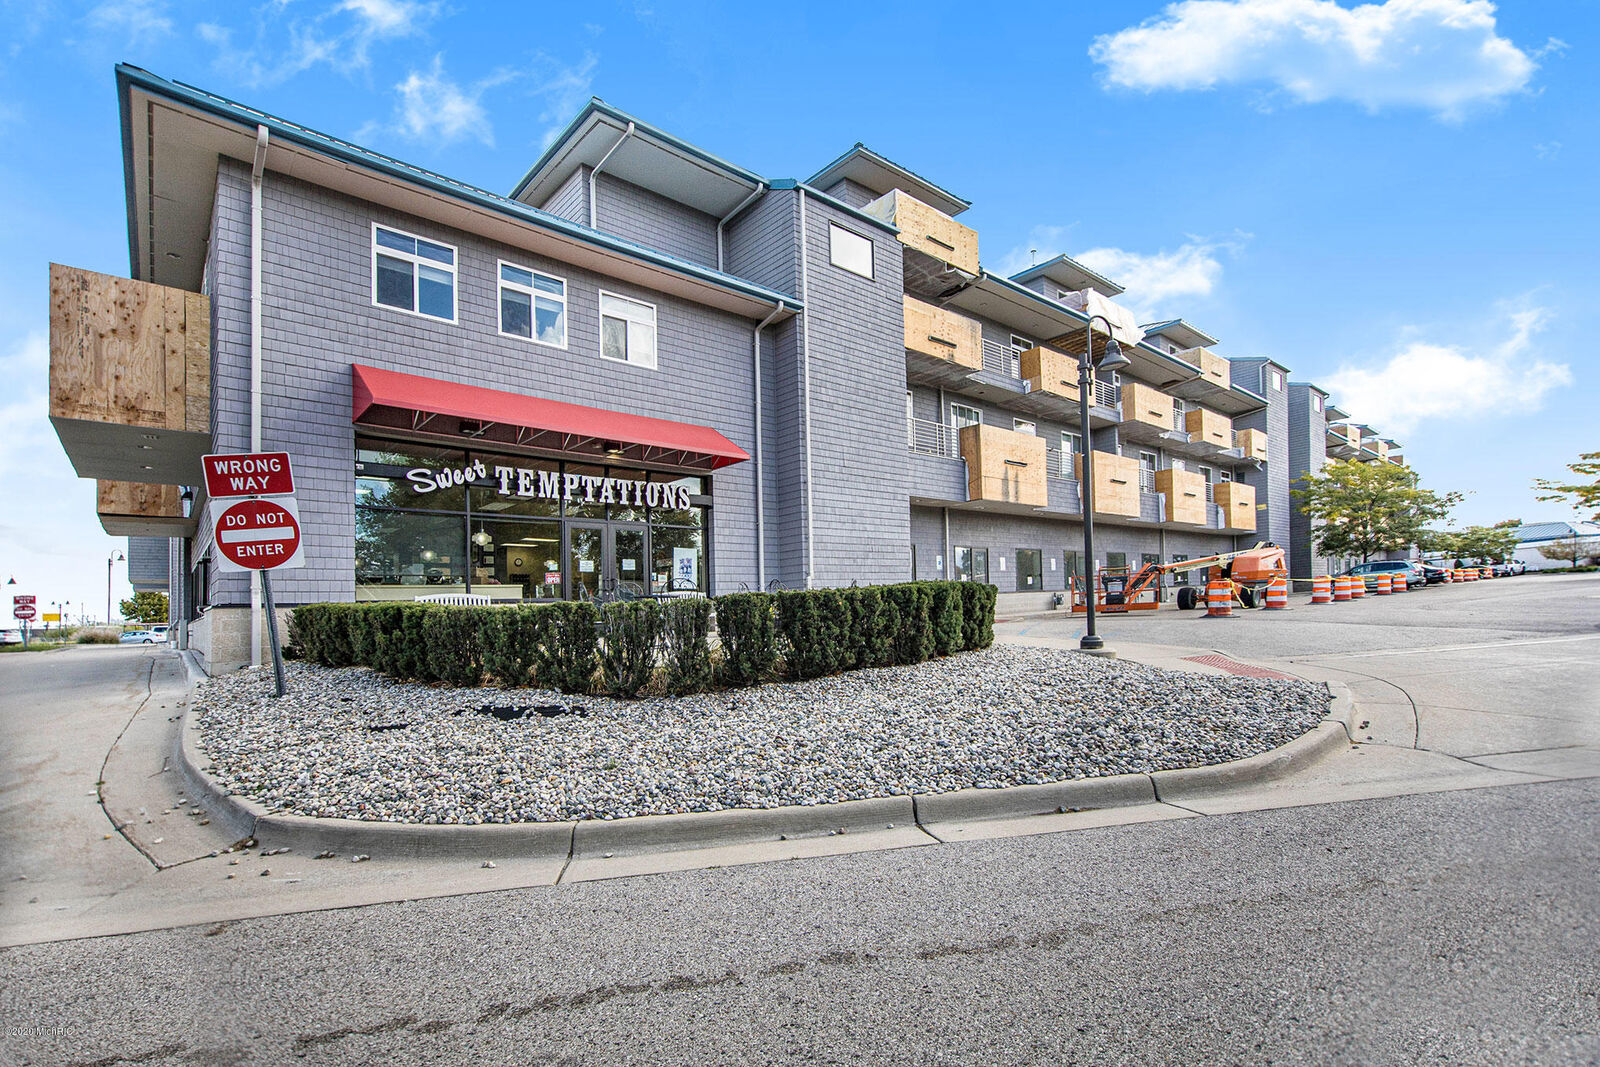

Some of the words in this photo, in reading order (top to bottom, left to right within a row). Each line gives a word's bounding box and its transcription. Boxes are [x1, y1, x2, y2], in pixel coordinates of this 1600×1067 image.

[214, 458, 281, 475] WRONG
[229, 476, 270, 491] WAY
[406, 459, 487, 494] Sweet
[494, 465, 691, 511] TEMPTATIONS
[226, 514, 247, 527] DO
[255, 512, 285, 525] NOT
[236, 543, 285, 557] ENTER
[547, 576, 560, 584] OPEN
